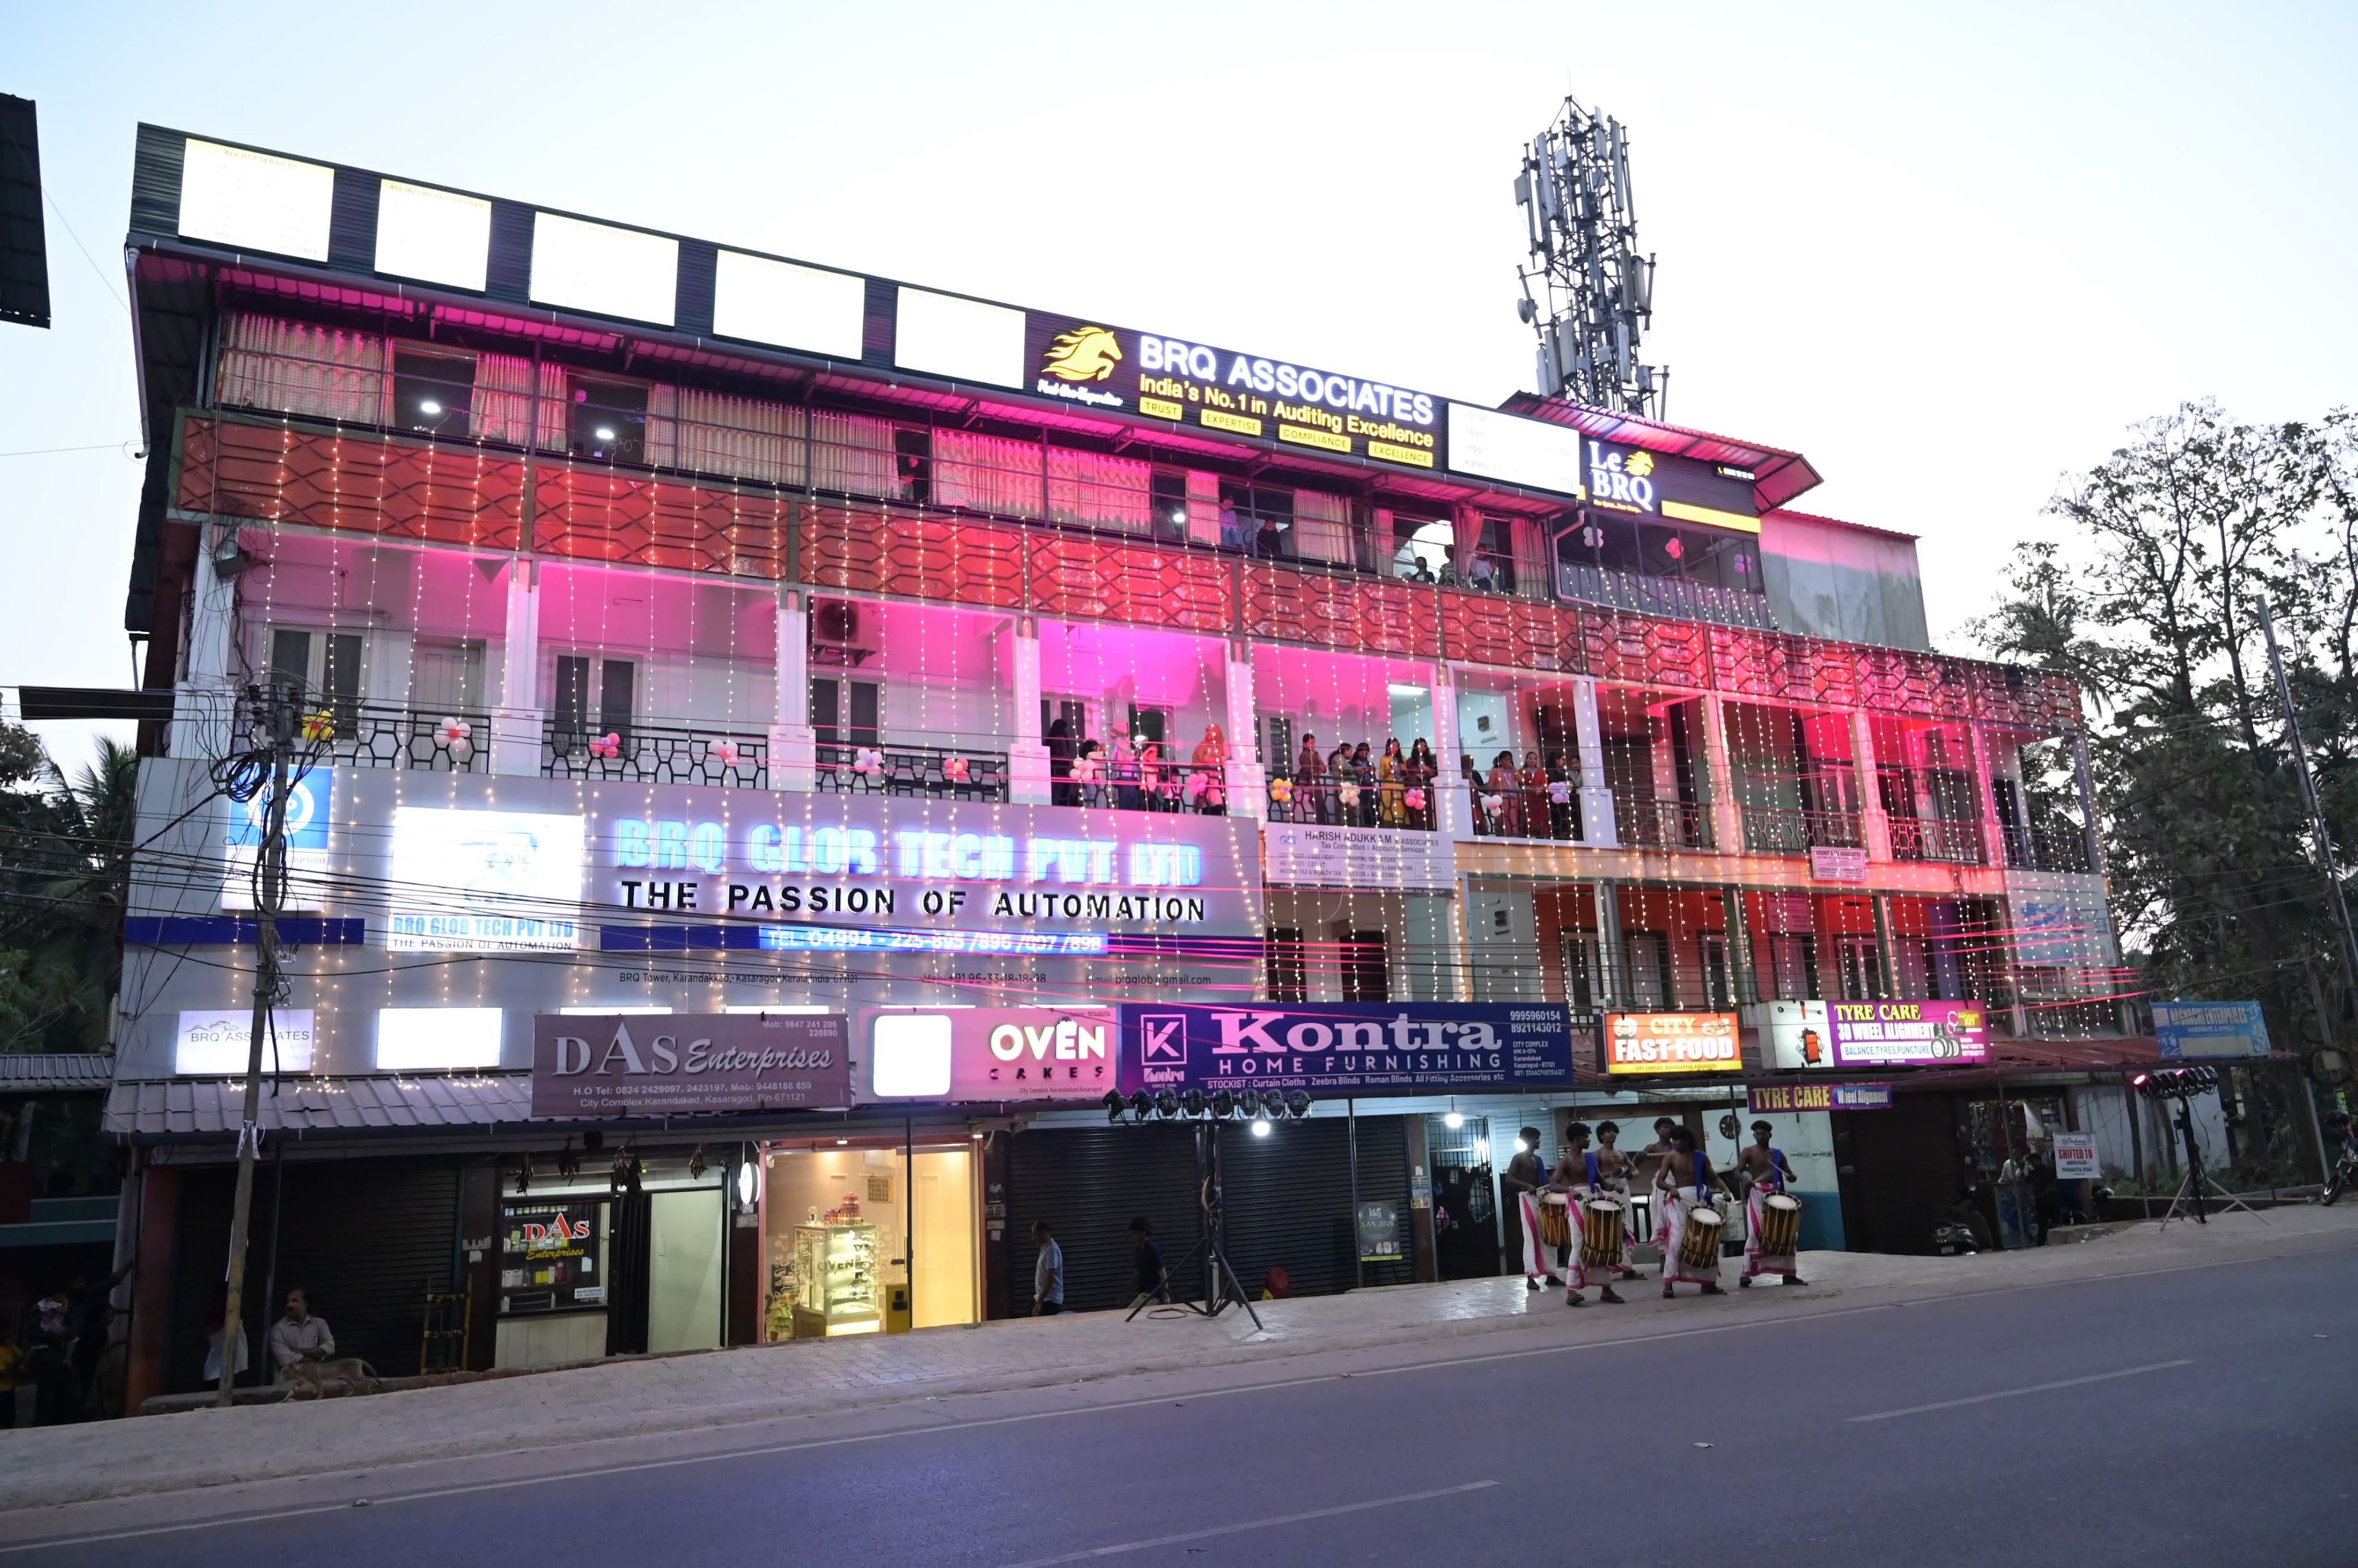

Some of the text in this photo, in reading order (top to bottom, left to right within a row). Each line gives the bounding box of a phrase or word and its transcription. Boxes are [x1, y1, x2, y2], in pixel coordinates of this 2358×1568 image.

[1140, 335, 1433, 425] BRQ ASSOCIATES
[1140, 374, 1199, 402] India's
[1251, 395, 1267, 414] in
[1274, 400, 1343, 434] Auditing
[1348, 415, 1434, 448] Excellence
[1145, 401, 1178, 417] TRUST
[1206, 414, 1257, 432] EXPERTISE
[1284, 429, 1347, 449] COMPLIANCE
[1373, 445, 1429, 464] EXCELLENCE
[1588, 441, 1621, 472] Le
[1590, 468, 1654, 512] BRQ
[1305, 831, 1341, 842] HARISH
[1401, 838, 1439, 847] ASSOCIATES
[618, 818, 1202, 887] BRQ GLOB TECH PVT LTD
[620, 881, 1204, 922] THE PASSION OF AUTOMATION
[475, 918, 512, 936] TECH
[619, 972, 640, 983] BRQ
[1510, 1010, 1561, 1021] 9995960154
[1834, 1004, 1922, 1021] TYRE CARE
[762, 1020, 783, 1028] Mob:
[785, 1020, 804, 1028] 9847
[806, 1020, 820, 1028] 241
[1211, 1011, 1503, 1055] Kontra
[1511, 1022, 1562, 1033] 8921143012
[1650, 1017, 1696, 1036] CITY
[1837, 1022, 1935, 1041] 3D WHEEL ALIGNMENT
[190, 1031, 309, 1042] BRQ ASSCATES
[990, 1020, 1105, 1061] OVEN
[551, 1021, 833, 1079] DAS Enterprises
[1614, 1036, 1734, 1062] FAST FOOD
[990, 1066, 1104, 1080] CAKES
[1219, 1053, 1501, 1075] HOME FURNISHING
[574, 1087, 593, 1096] H.O
[596, 1086, 613, 1095] Tel:
[616, 1085, 639, 1095] 0824
[796, 1081, 812, 1090] 859
[1207, 1073, 1504, 1089] STOCKIST Curtain Cloths Zeebra Blinds Roman Blinds All Fitting Accessories etc
[580, 1098, 599, 1109] City
[601, 1097, 643, 1107] Complex
[1753, 1087, 1791, 1109] TYRE
[1793, 1085, 1831, 1108] CARE
[1857, 1089, 1889, 1105] Alignment
[2058, 1149, 2093, 1160] SHIFTED TO
[523, 1213, 590, 1242] DAS
[526, 1246, 585, 1261] Enterprises
[817, 1259, 854, 1272] OVEN
